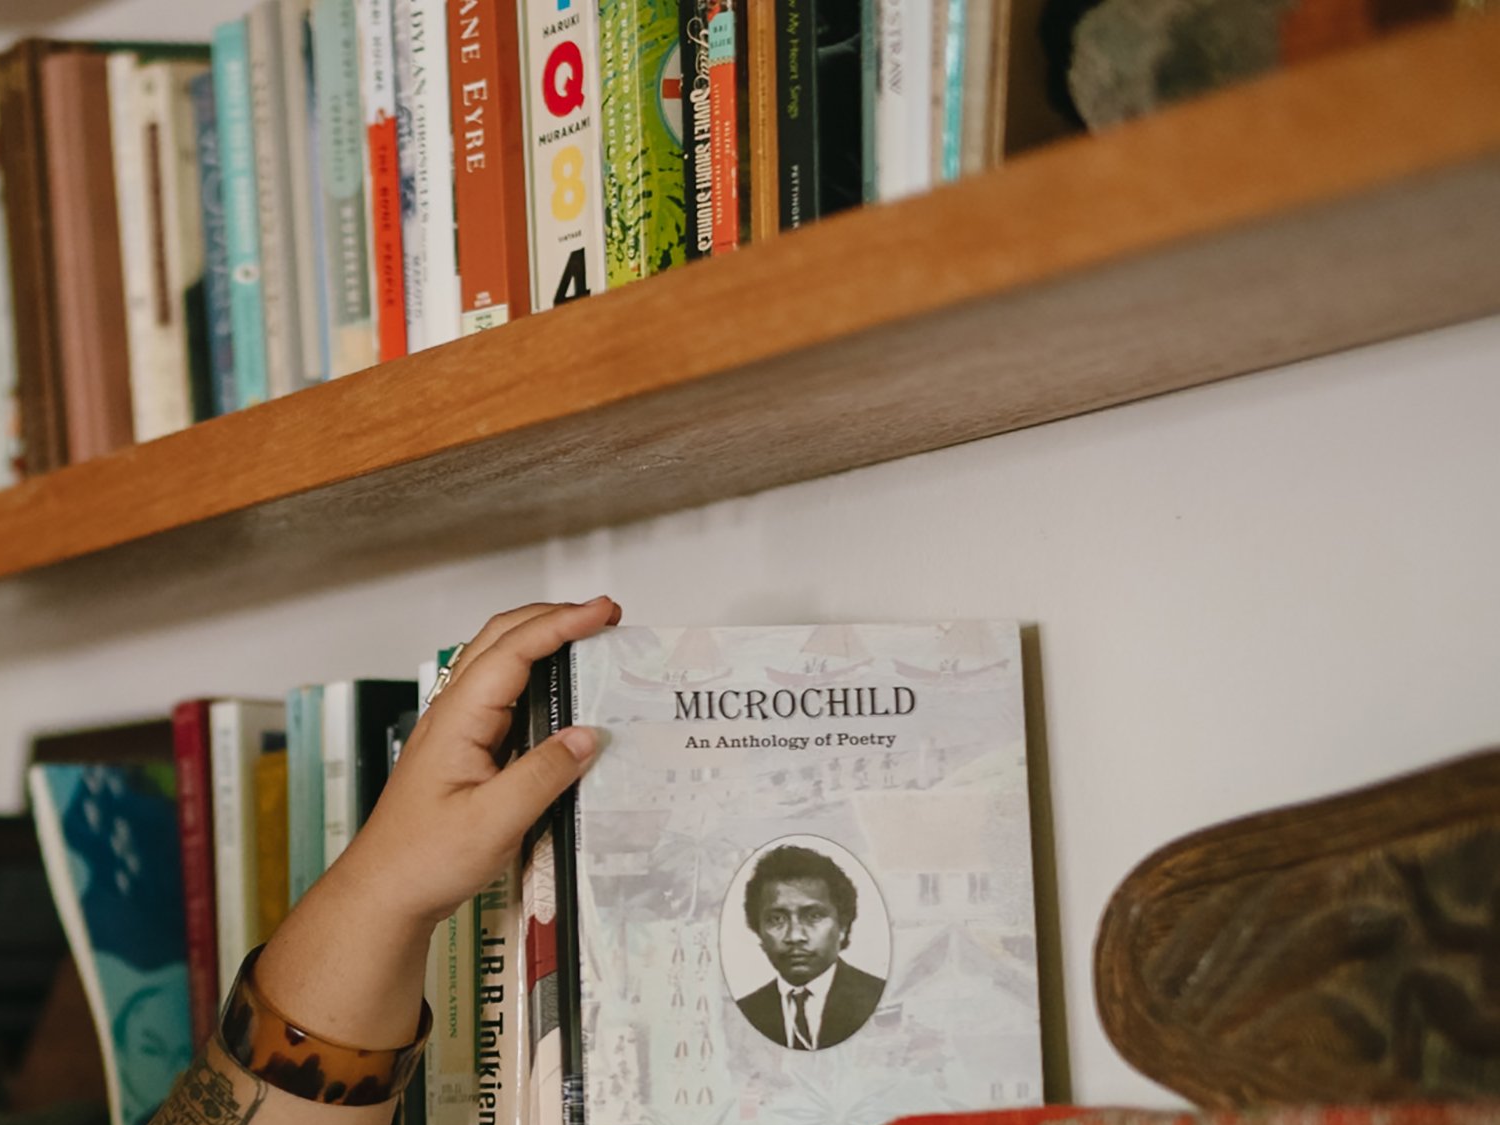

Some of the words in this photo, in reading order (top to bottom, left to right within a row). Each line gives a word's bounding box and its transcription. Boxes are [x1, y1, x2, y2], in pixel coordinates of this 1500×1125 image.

[542, 14, 580, 38] HARUKI
[410, 10, 426, 96] DYLAN
[789, 41, 799, 80] Heart
[542, 40, 585, 117] Q
[787, 85, 800, 119] Sings
[462, 79, 488, 173] EYRE
[538, 117, 591, 146] MURAKAMI
[689, 86, 712, 141] SOVIET
[552, 145, 586, 222] 8
[694, 144, 712, 189] SHORT
[696, 189, 713, 251] STORIES
[553, 246, 591, 309] 4
[674, 687, 916, 719] MICROCHILD
[685, 736, 710, 748] An
[716, 734, 810, 750] Anthology
[815, 733, 832, 746] of
[837, 733, 897, 748] Poetry
